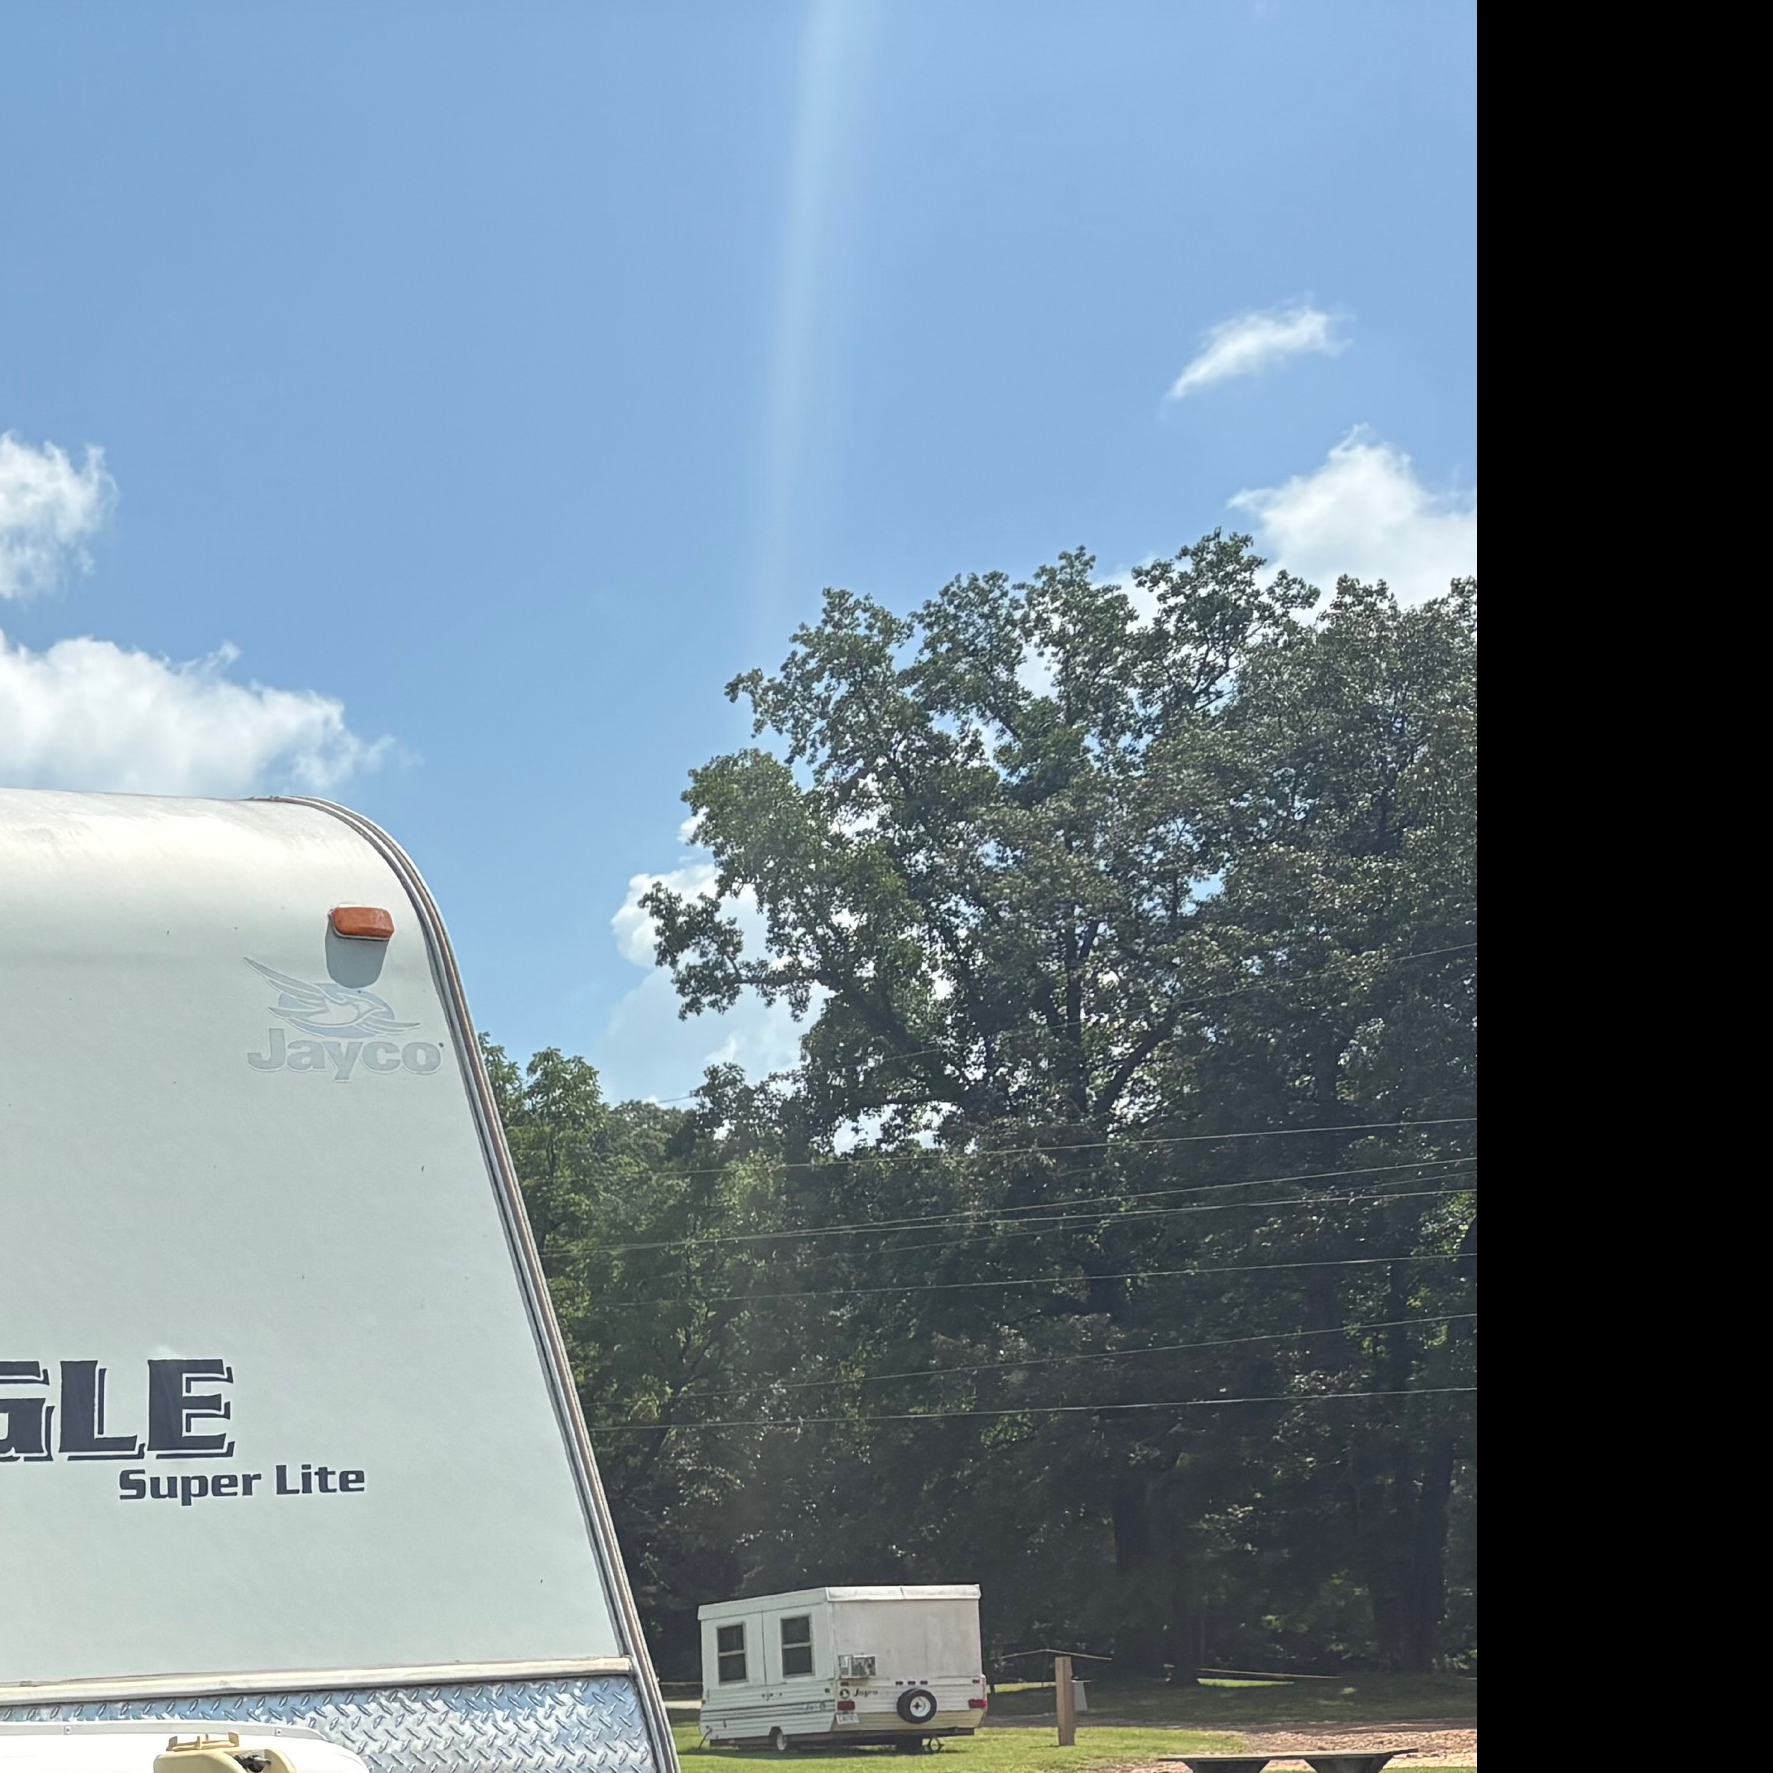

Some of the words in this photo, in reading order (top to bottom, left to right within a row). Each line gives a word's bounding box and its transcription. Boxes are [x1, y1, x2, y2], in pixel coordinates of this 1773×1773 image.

[246, 1027, 442, 1082] Jayco
[118, 1468, 262, 1506] Super
[275, 1464, 366, 1495] Lite
